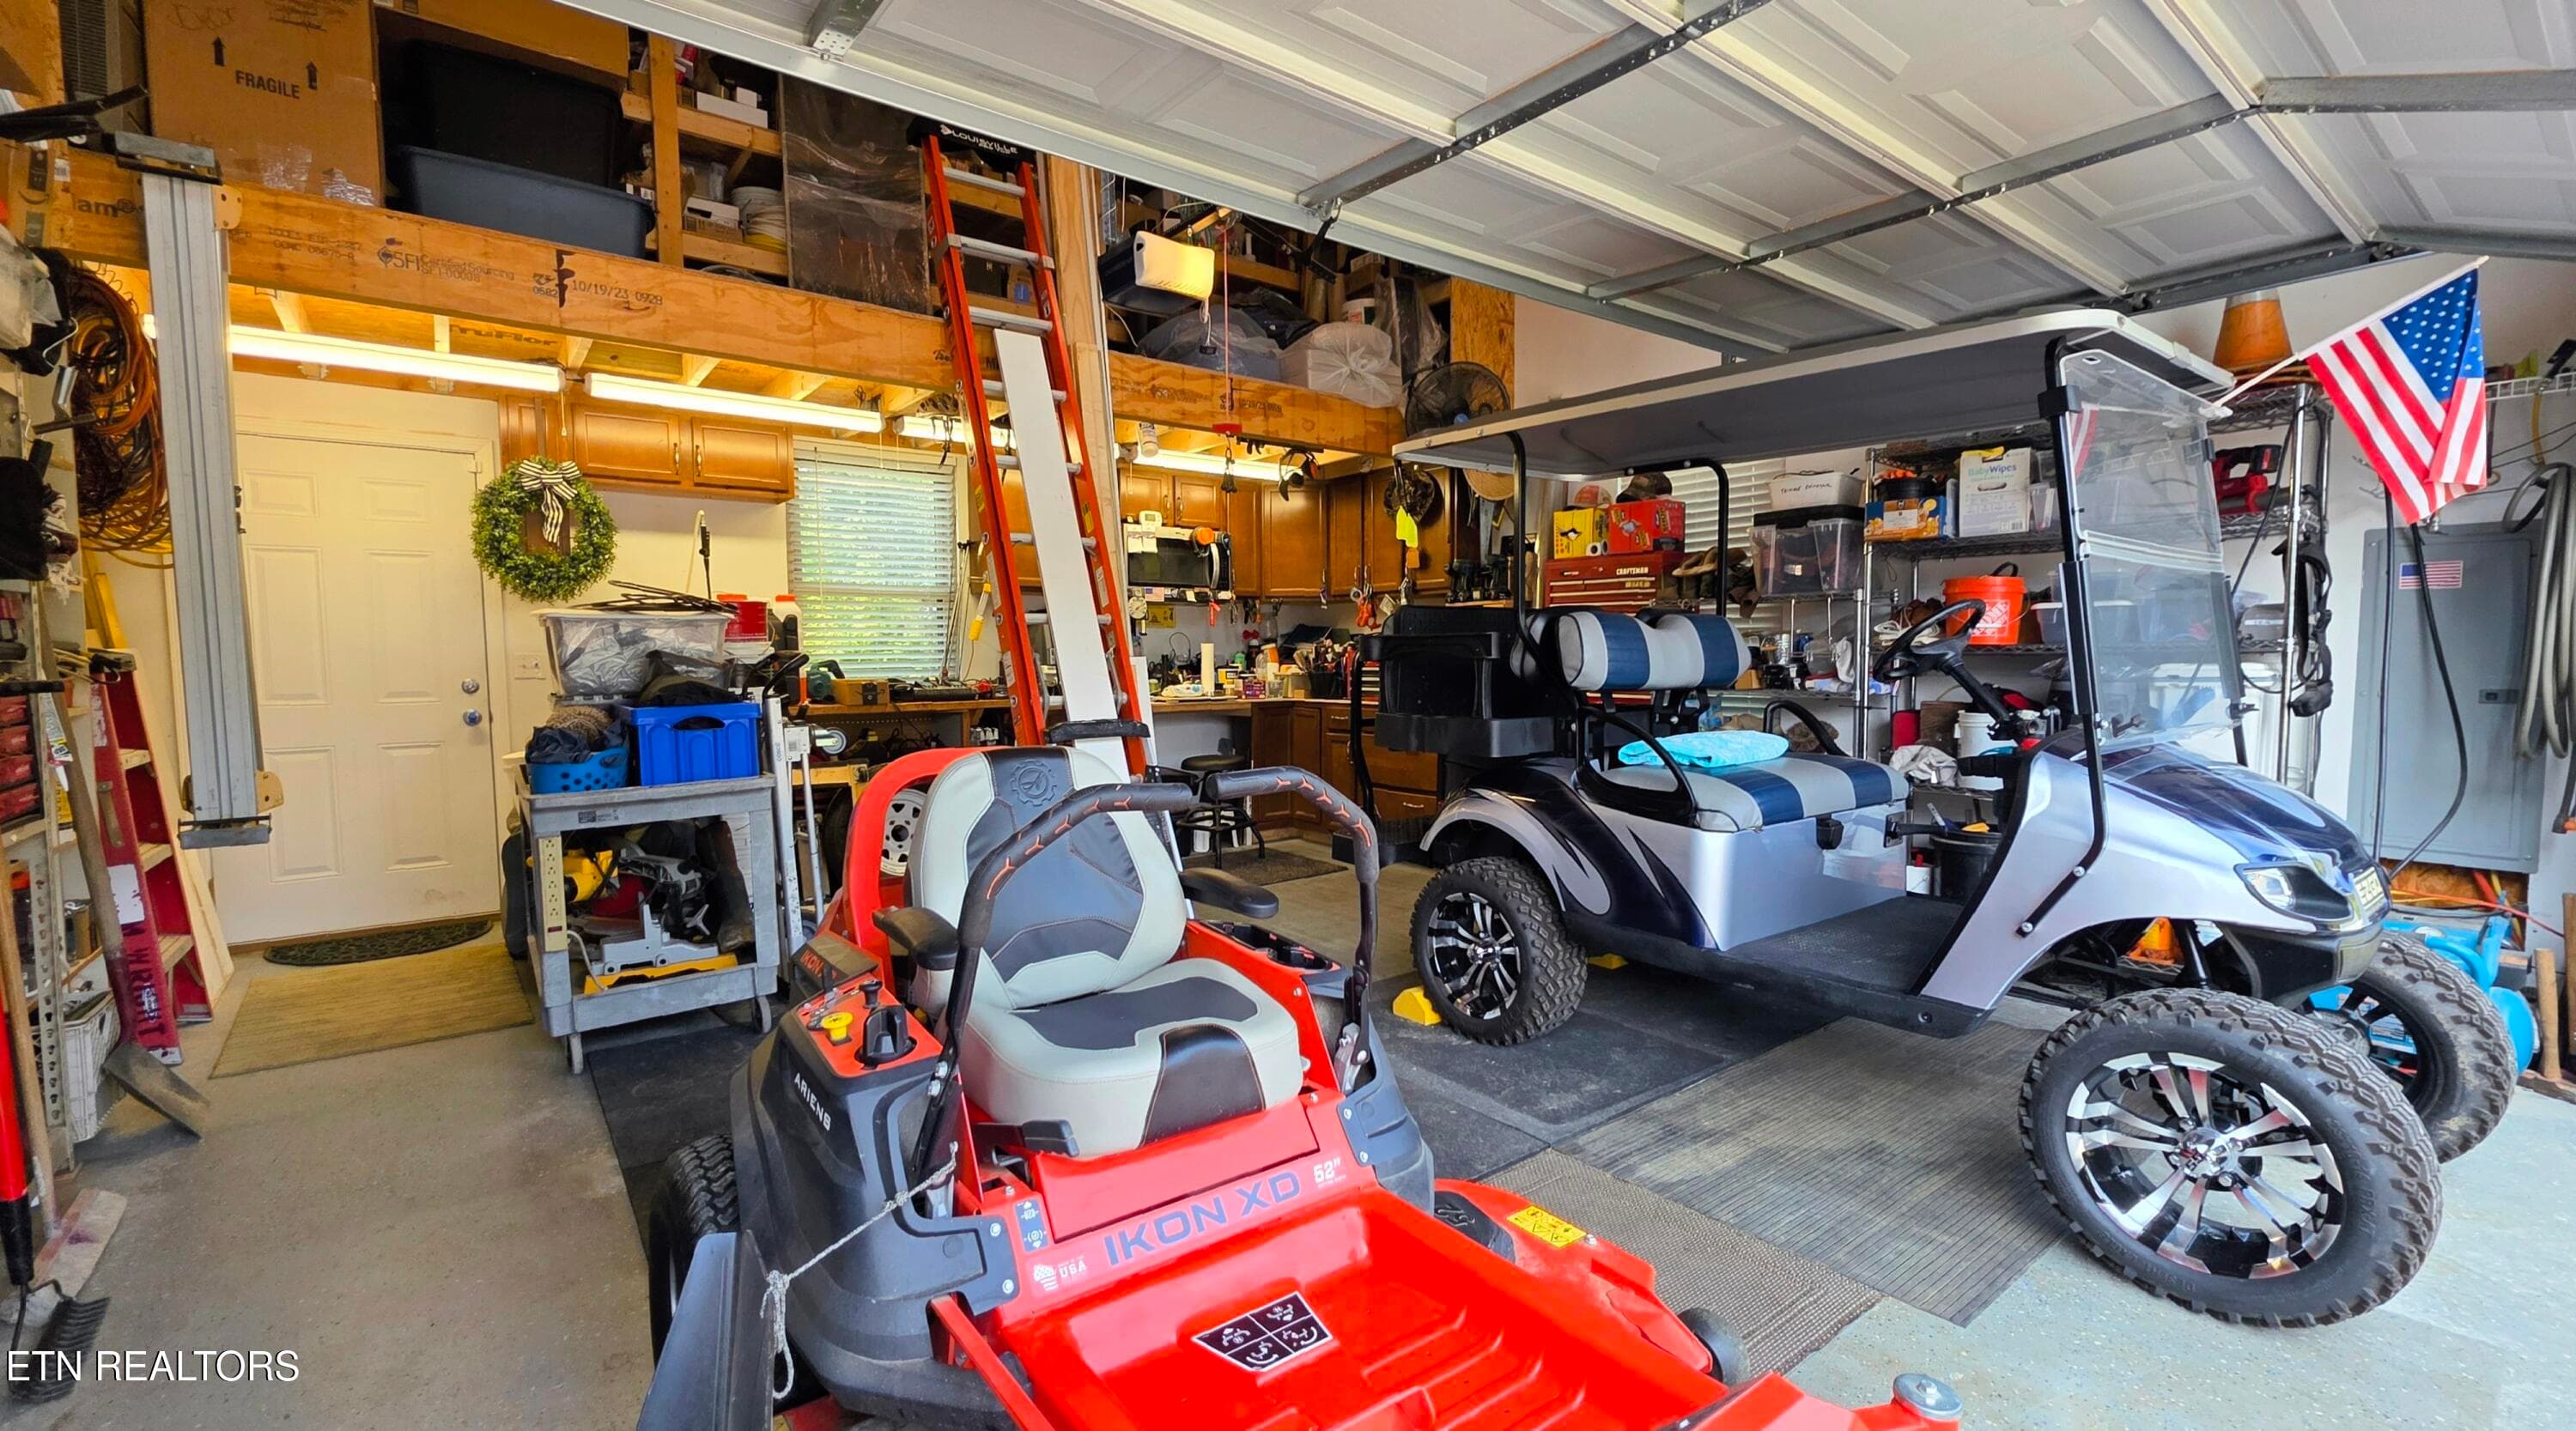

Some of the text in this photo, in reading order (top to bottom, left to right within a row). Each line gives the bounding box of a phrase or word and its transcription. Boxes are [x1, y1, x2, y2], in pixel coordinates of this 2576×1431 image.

[235, 70, 301, 100] FRAGILE
[951, 130, 1018, 155] LOUISVILLE
[572, 280, 663, 306] 10/19/23 0928
[1616, 567, 1649, 575] CRAFTSMAN
[799, 949, 824, 978] IKON
[794, 1072, 832, 1131] ARIENS
[1103, 1171, 1301, 1266] IKON XD
[1059, 1258, 1087, 1278] USA
